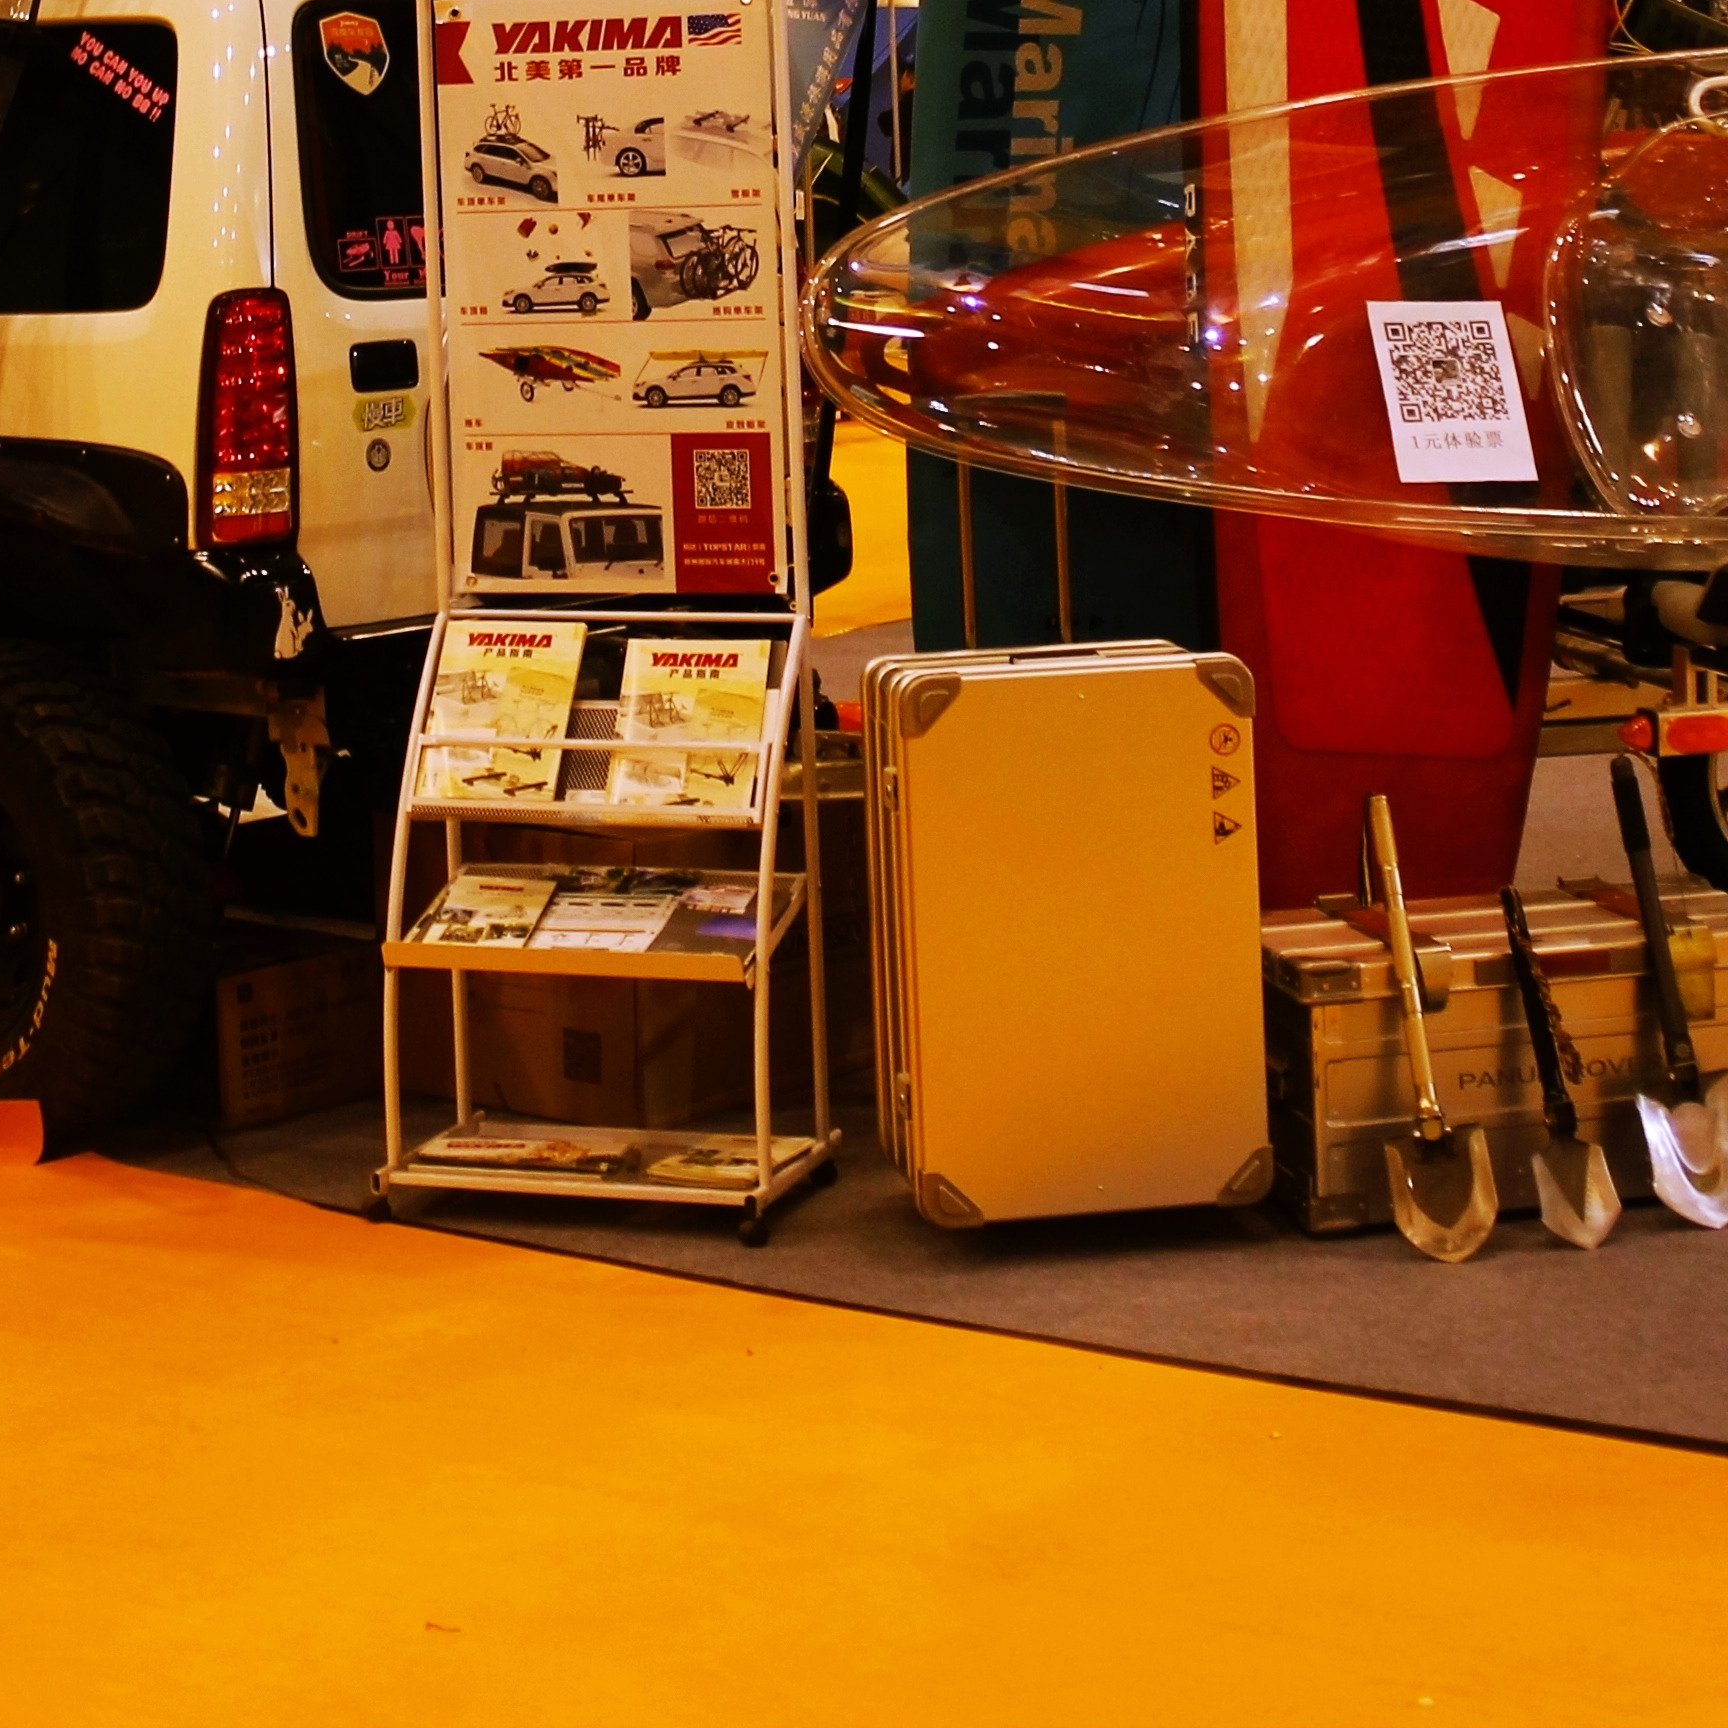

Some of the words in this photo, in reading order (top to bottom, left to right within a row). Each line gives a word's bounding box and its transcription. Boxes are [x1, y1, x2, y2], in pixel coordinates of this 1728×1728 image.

[492, 16, 683, 55] YAKIMA
[70, 45, 88, 66] NO
[89, 61, 114, 85] CAN
[114, 79, 133, 100] NO
[80, 30, 104, 57] YOU
[103, 50, 128, 75] CAN
[128, 67, 152, 94] YOU
[152, 87, 170, 107] UP
[494, 55, 682, 83] 北美第一品牌
[1411, 430, 1504, 451] 1元体验票
[467, 633, 552, 648] YAKIMA
[651, 653, 739, 667] YAKIMA
[1459, 1067, 1542, 1091] PANU
